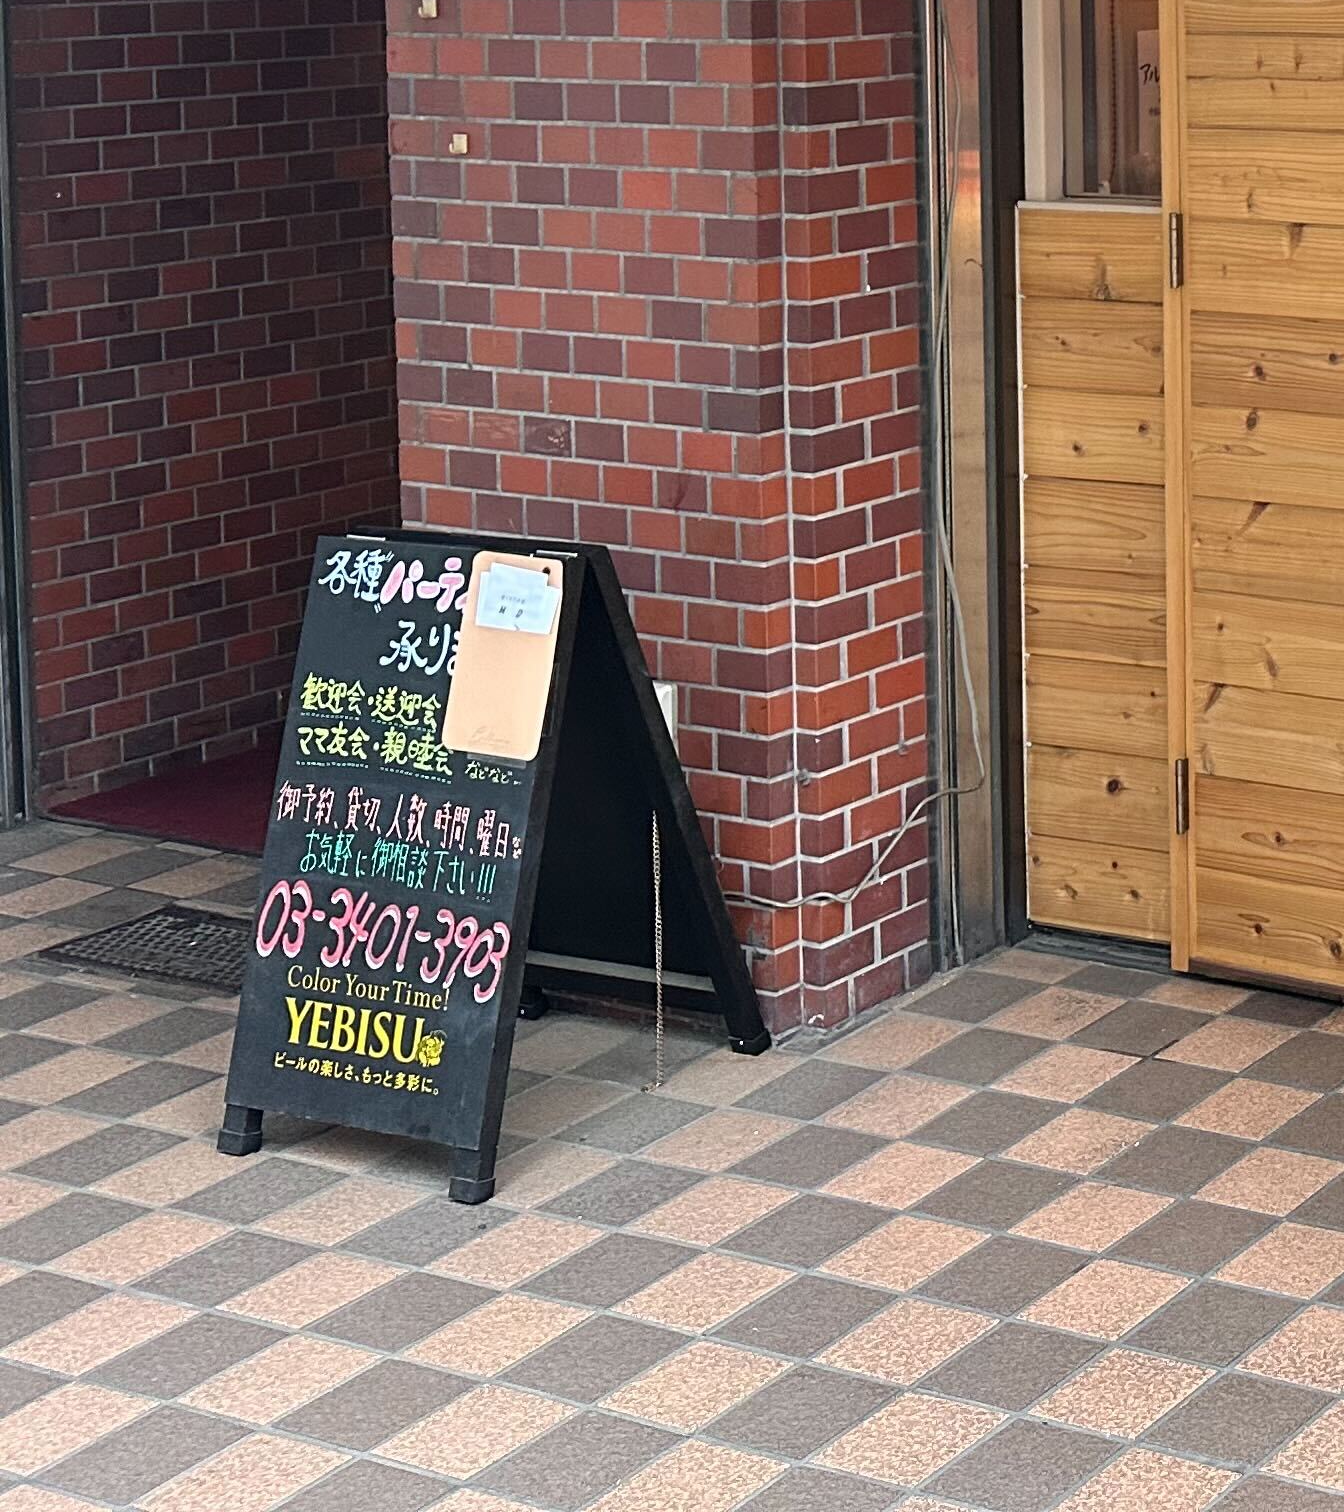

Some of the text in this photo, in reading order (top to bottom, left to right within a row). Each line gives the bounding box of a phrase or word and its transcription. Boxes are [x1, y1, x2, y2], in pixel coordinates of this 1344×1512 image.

[256, 879, 510, 1003] 03-3401-3903
[287, 965, 450, 1011] Color Your Time!
[285, 996, 426, 1063] YEBISU
[273, 1051, 439, 1096] ビールの楽しさ、もっと多彩に。
